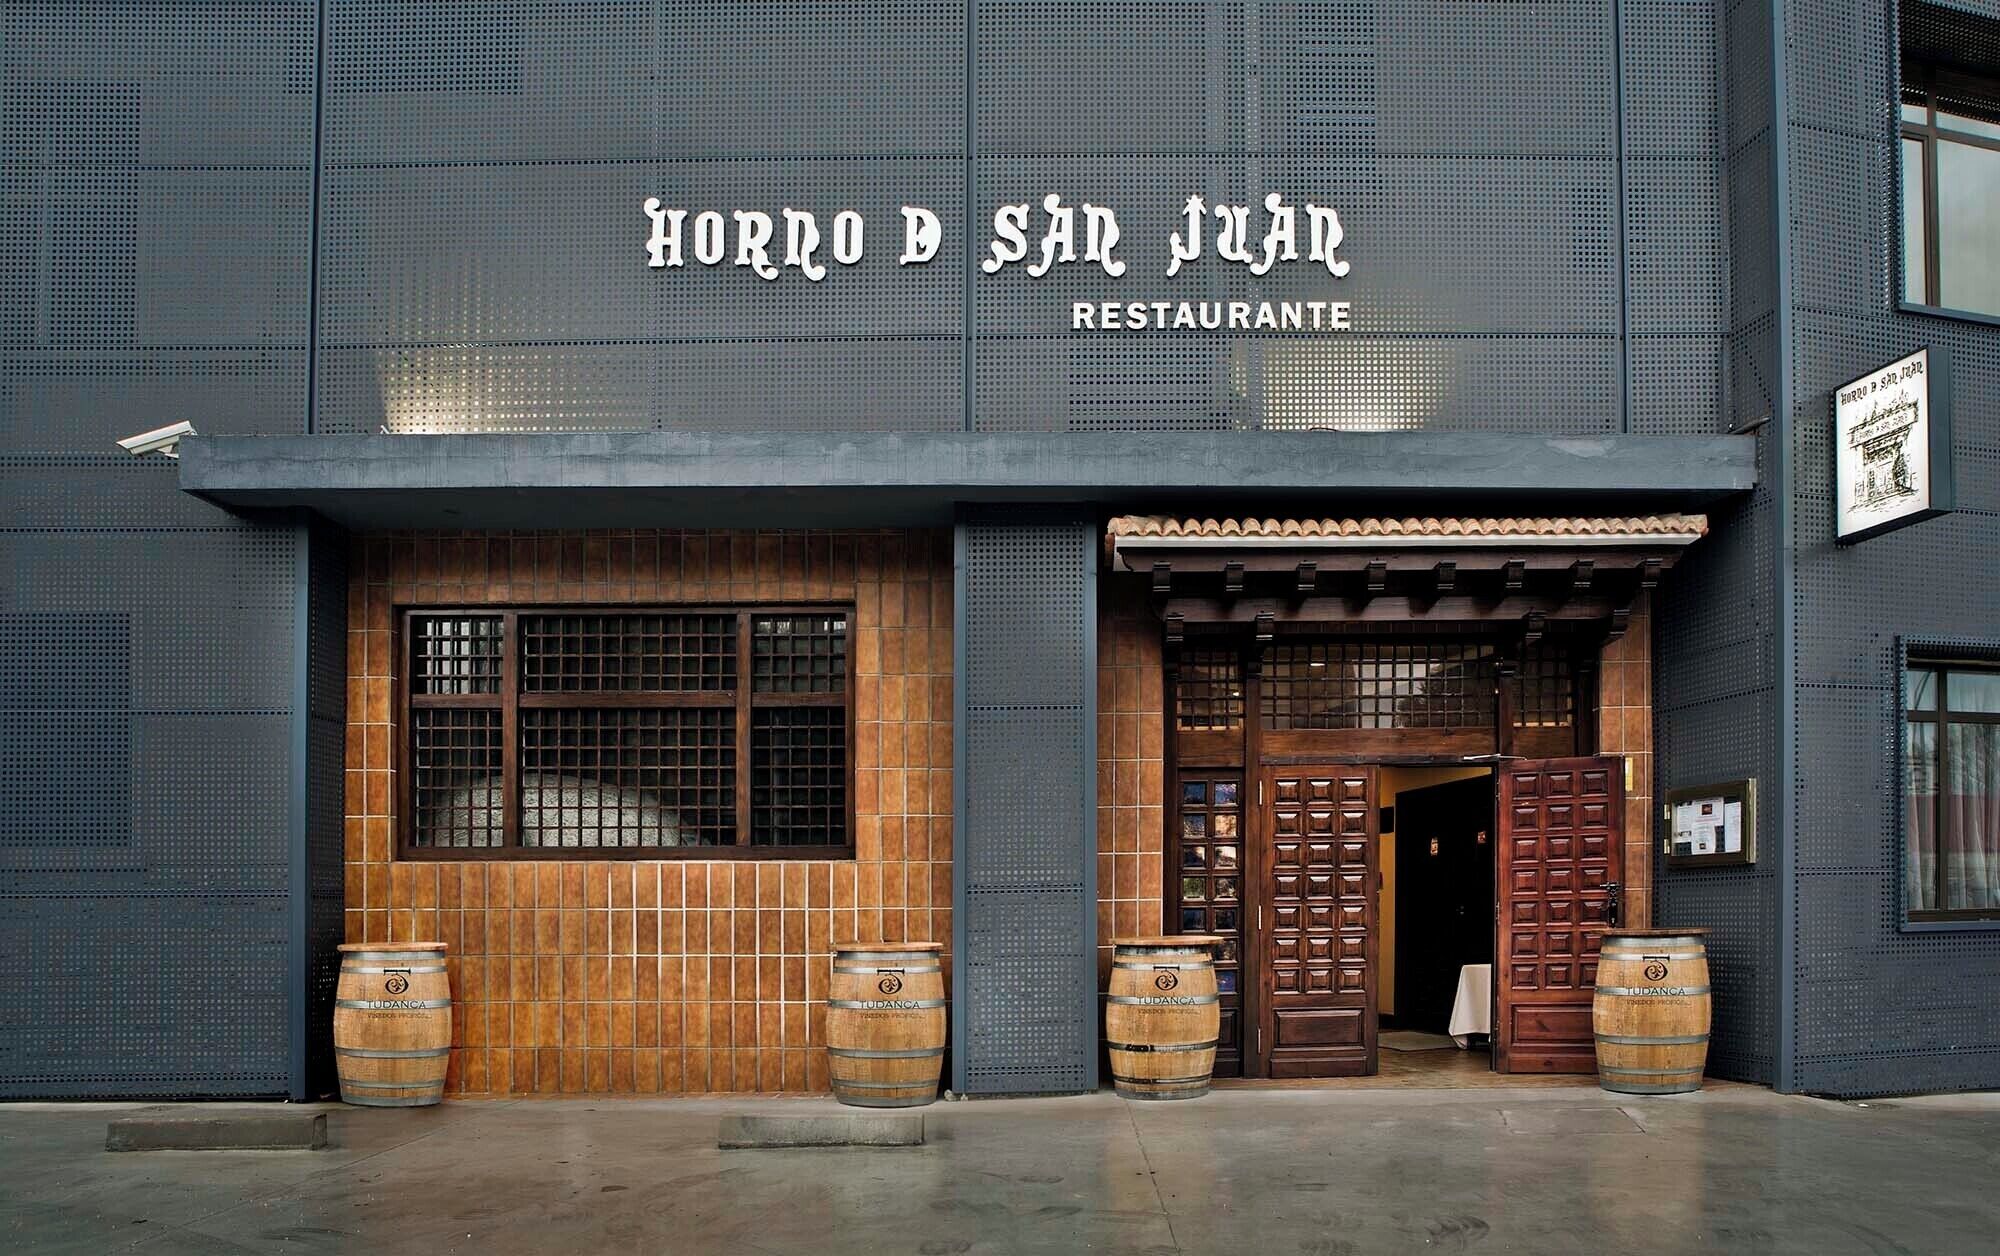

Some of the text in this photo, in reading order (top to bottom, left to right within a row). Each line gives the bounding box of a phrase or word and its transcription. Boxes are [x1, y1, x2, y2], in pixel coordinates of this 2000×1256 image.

[643, 197, 864, 281] HORNO
[982, 193, 1126, 277] SAN
[1166, 193, 1350, 277] JUAN
[1073, 302, 1350, 330] RESTAURANTE
[1841, 386, 1868, 406] HORNO
[1880, 372, 1898, 391] SAN
[1900, 361, 1924, 383] JUAN
[1626, 986, 1686, 996] TUDANCA
[367, 1000, 427, 1009] TUDANCA
[859, 1000, 921, 1009] TUDANCA
[1136, 996, 1196, 1006] TUDANCA
